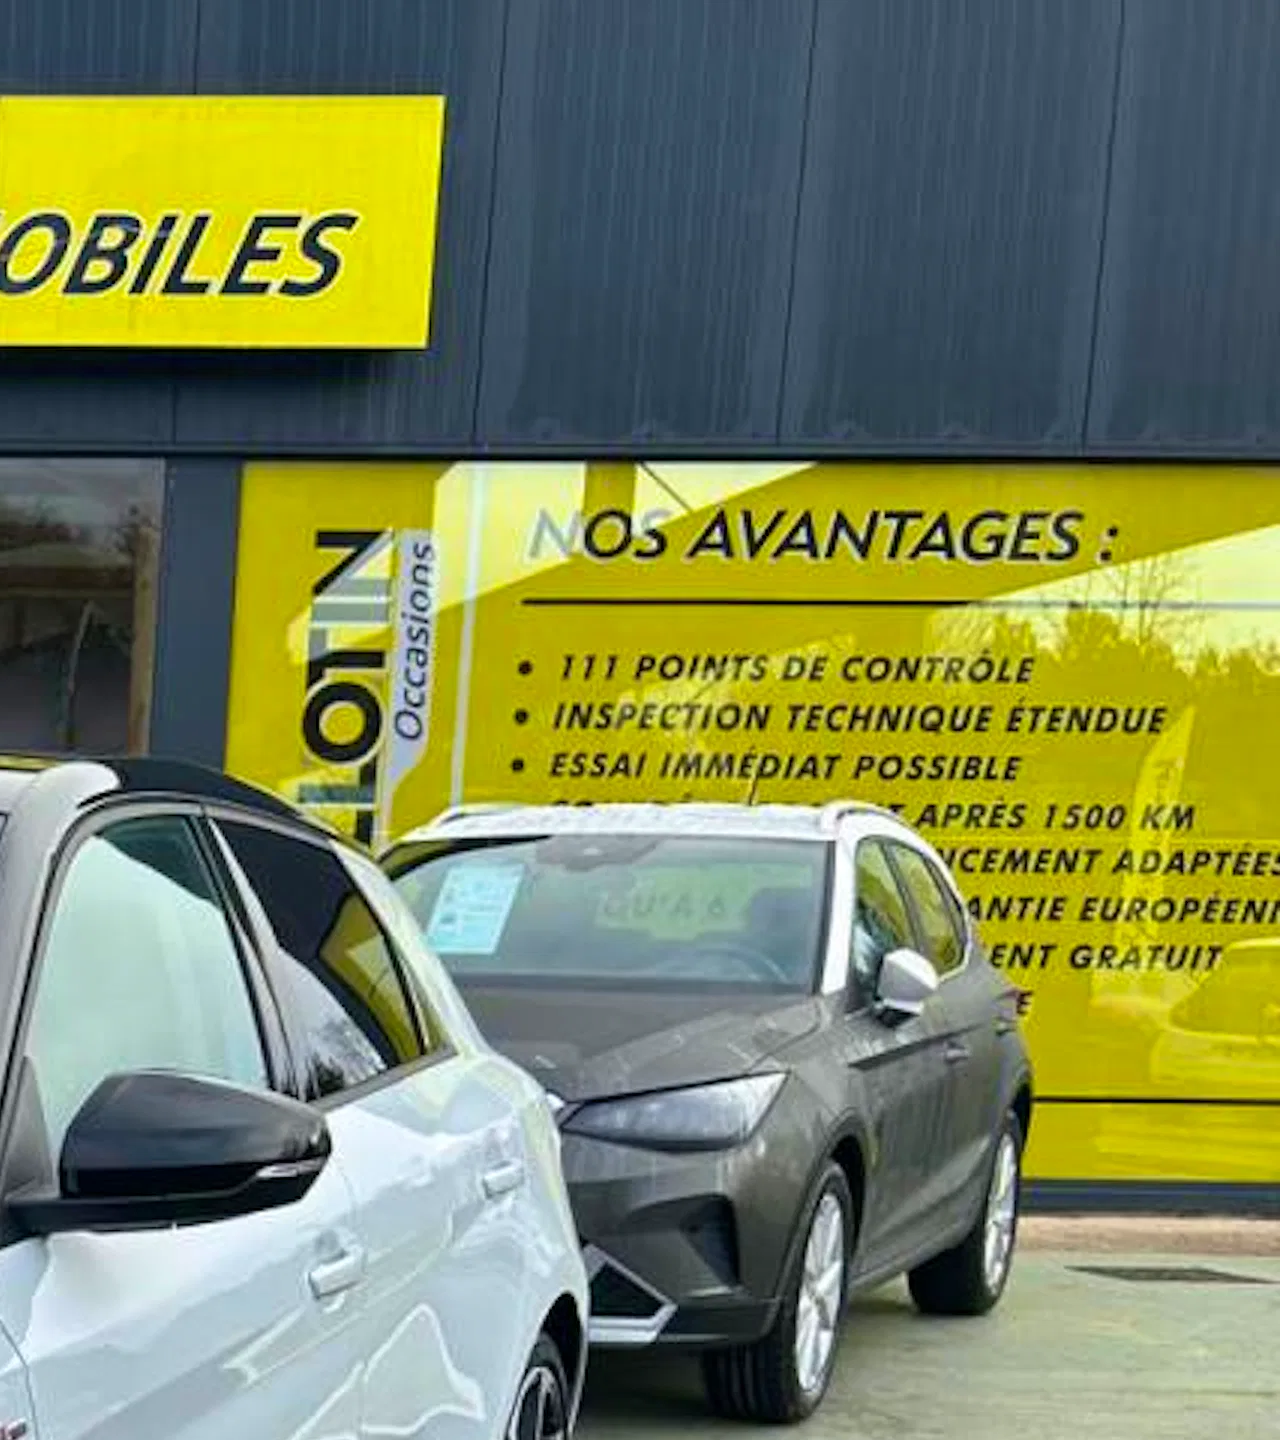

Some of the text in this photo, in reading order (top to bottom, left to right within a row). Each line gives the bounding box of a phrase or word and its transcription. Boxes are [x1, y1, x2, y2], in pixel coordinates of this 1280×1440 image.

[526, 506, 672, 560] NOS
[680, 507, 1085, 562] AVANTAGES
[394, 542, 433, 741] Occasions
[560, 648, 1035, 684] 111 POINTS DE CONTRÔLE
[297, 530, 393, 847] LOTIN
[552, 696, 1168, 735] INSPECTION TECHNIQUE ÉTENDUE
[549, 745, 1023, 781] ESSAI IMMÉDIAT POSSIBLE
[1044, 802, 1127, 830] 1500
[1140, 803, 1196, 832] KM
[1069, 943, 1223, 971] GRATUIT
